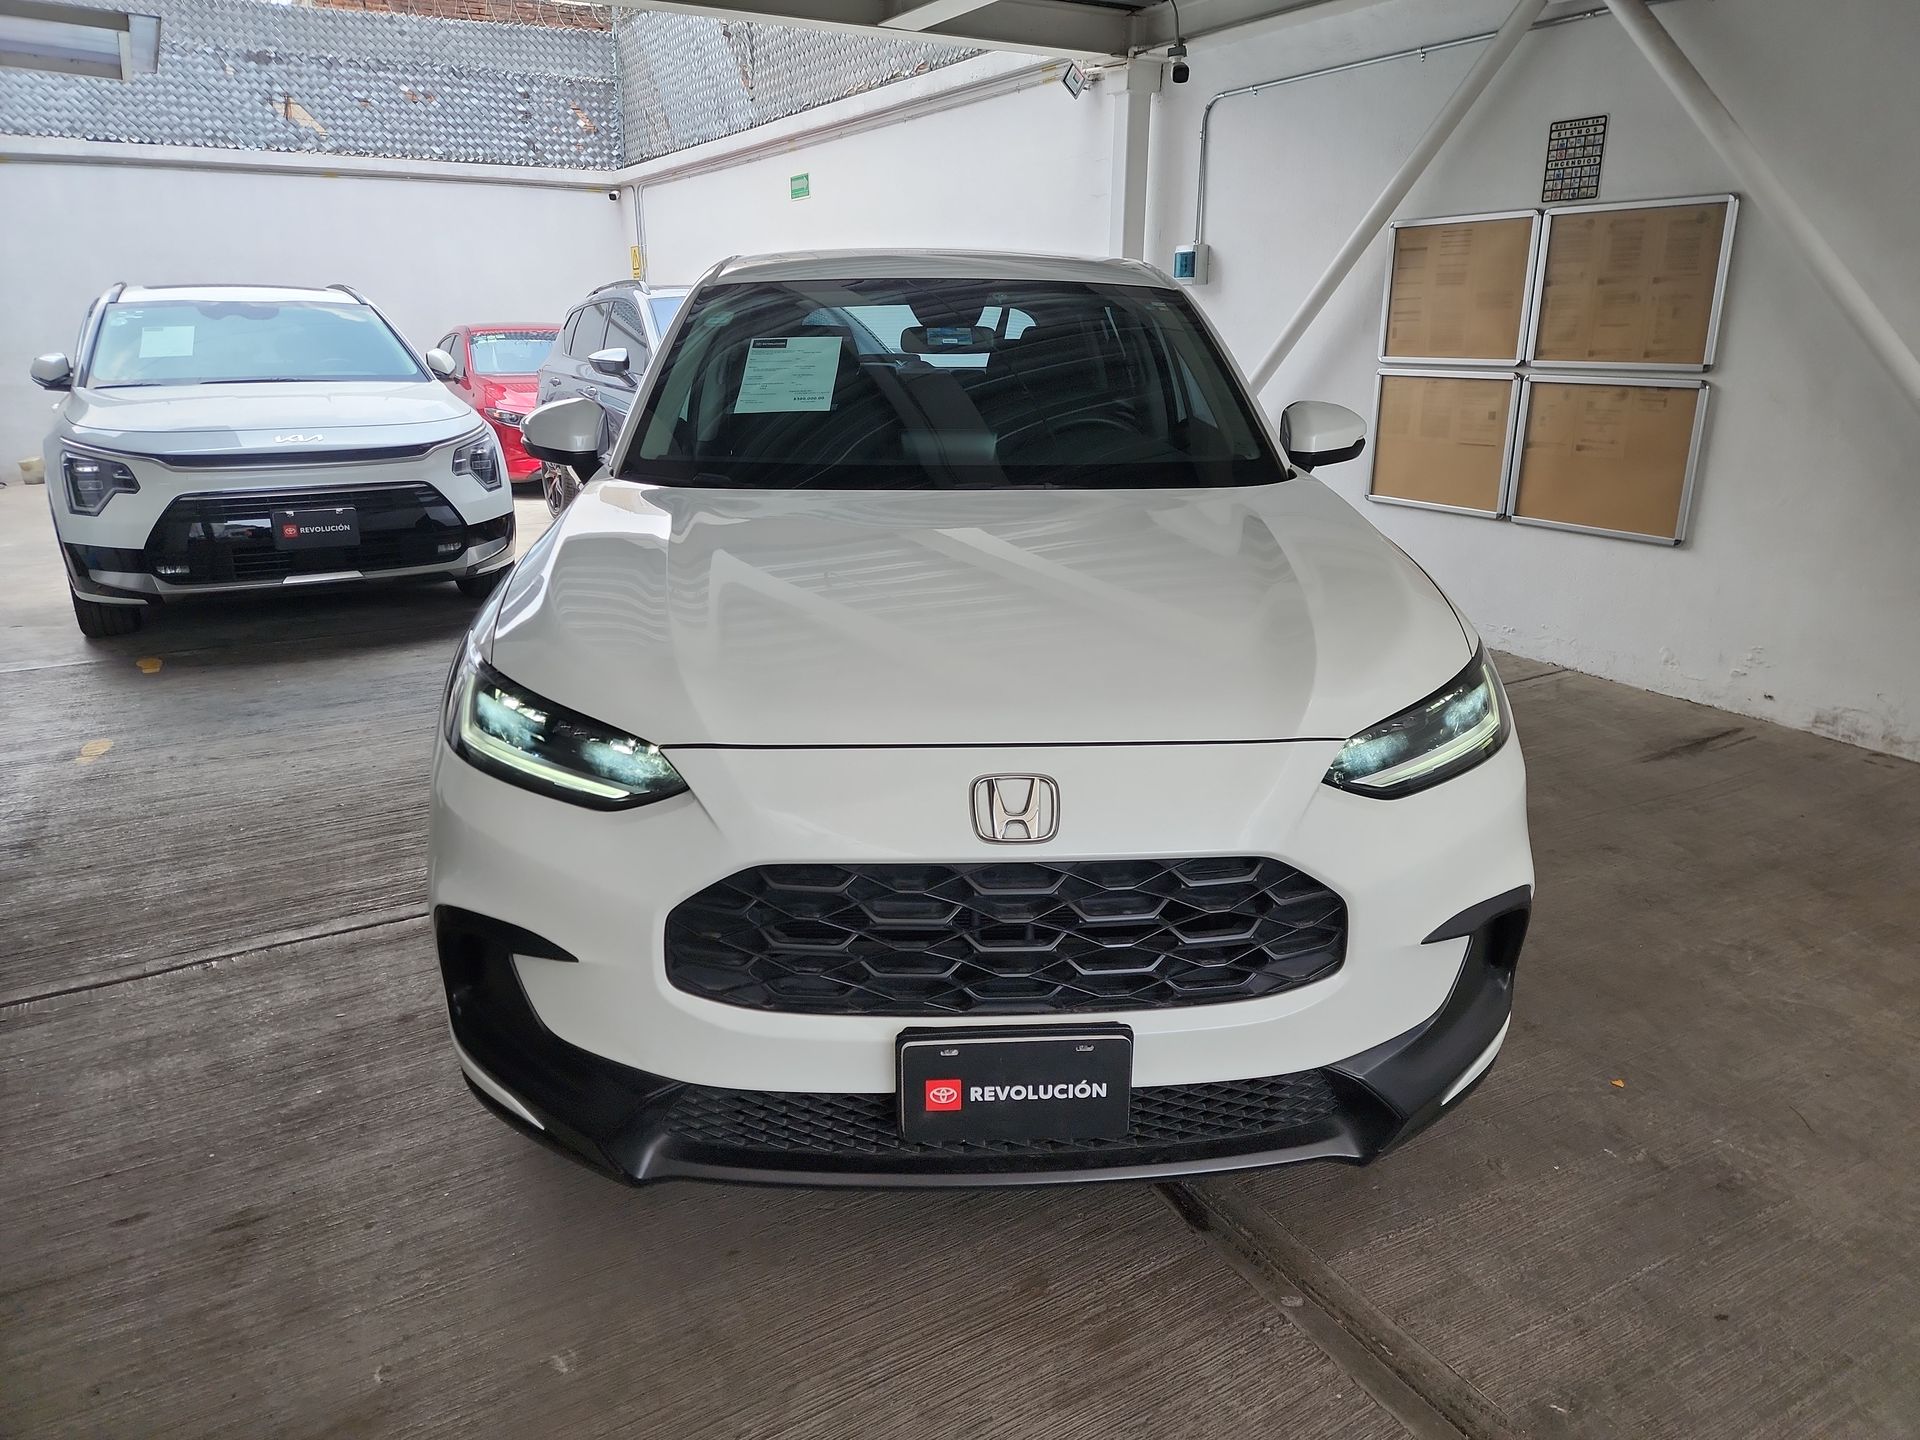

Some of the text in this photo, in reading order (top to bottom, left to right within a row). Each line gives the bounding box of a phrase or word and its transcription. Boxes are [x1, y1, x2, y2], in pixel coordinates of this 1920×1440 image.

[1557, 127, 1598, 136] SISMOS
[1550, 158, 1597, 168] INCENDIOS
[299, 523, 351, 534] REVOLUCIÓN
[969, 1079, 1108, 1102] REVOLUCIÓN
